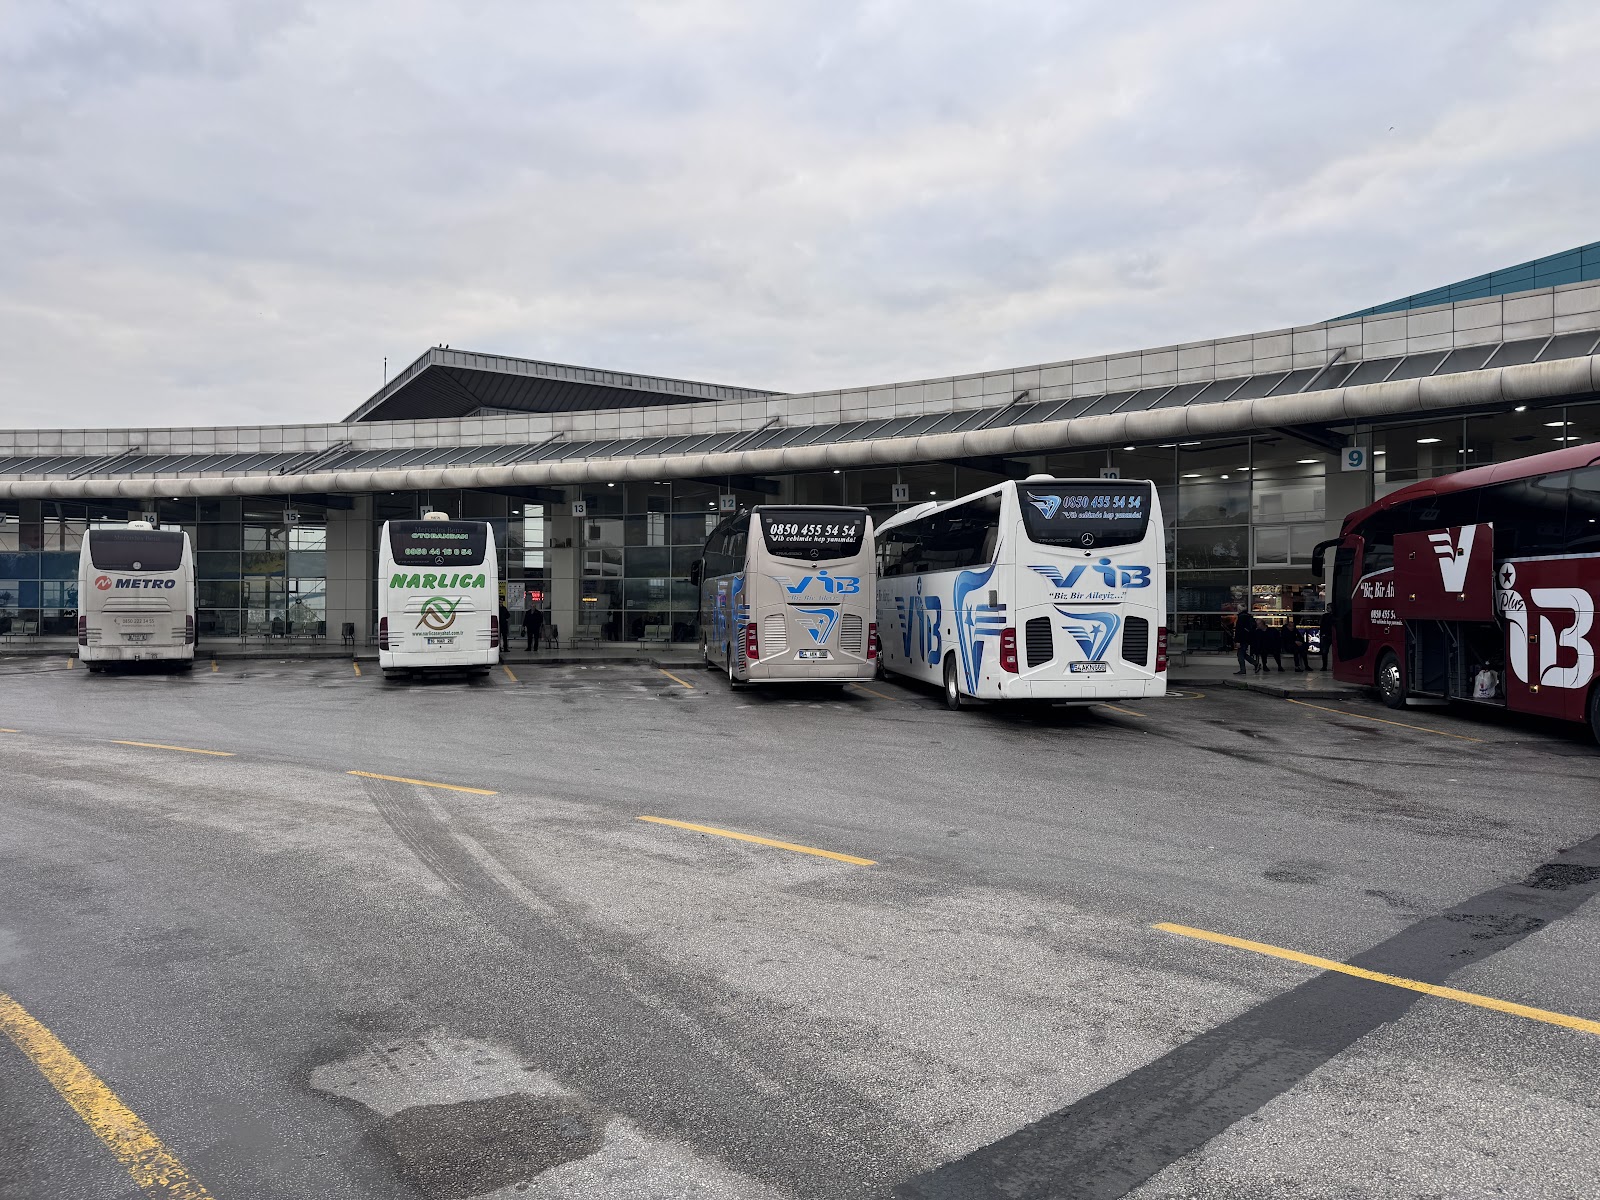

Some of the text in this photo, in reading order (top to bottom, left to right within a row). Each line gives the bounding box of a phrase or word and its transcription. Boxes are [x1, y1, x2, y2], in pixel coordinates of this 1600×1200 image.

[1347, 450, 1363, 467] 9
[894, 488, 907, 498] 11
[722, 499, 735, 508] 12
[1063, 495, 1141, 509] 0850 455 54 54
[574, 504, 584, 513] 13
[144, 515, 155, 523] 16
[285, 512, 297, 522] 15
[770, 523, 856, 536] 0850 455 54 54
[115, 578, 176, 589] METRO
[389, 573, 486, 589] NARLICA
[1374, 581, 1385, 598] Bir
[1070, 592, 1085, 600] Bir
[1500, 590, 1524, 612] Plus
